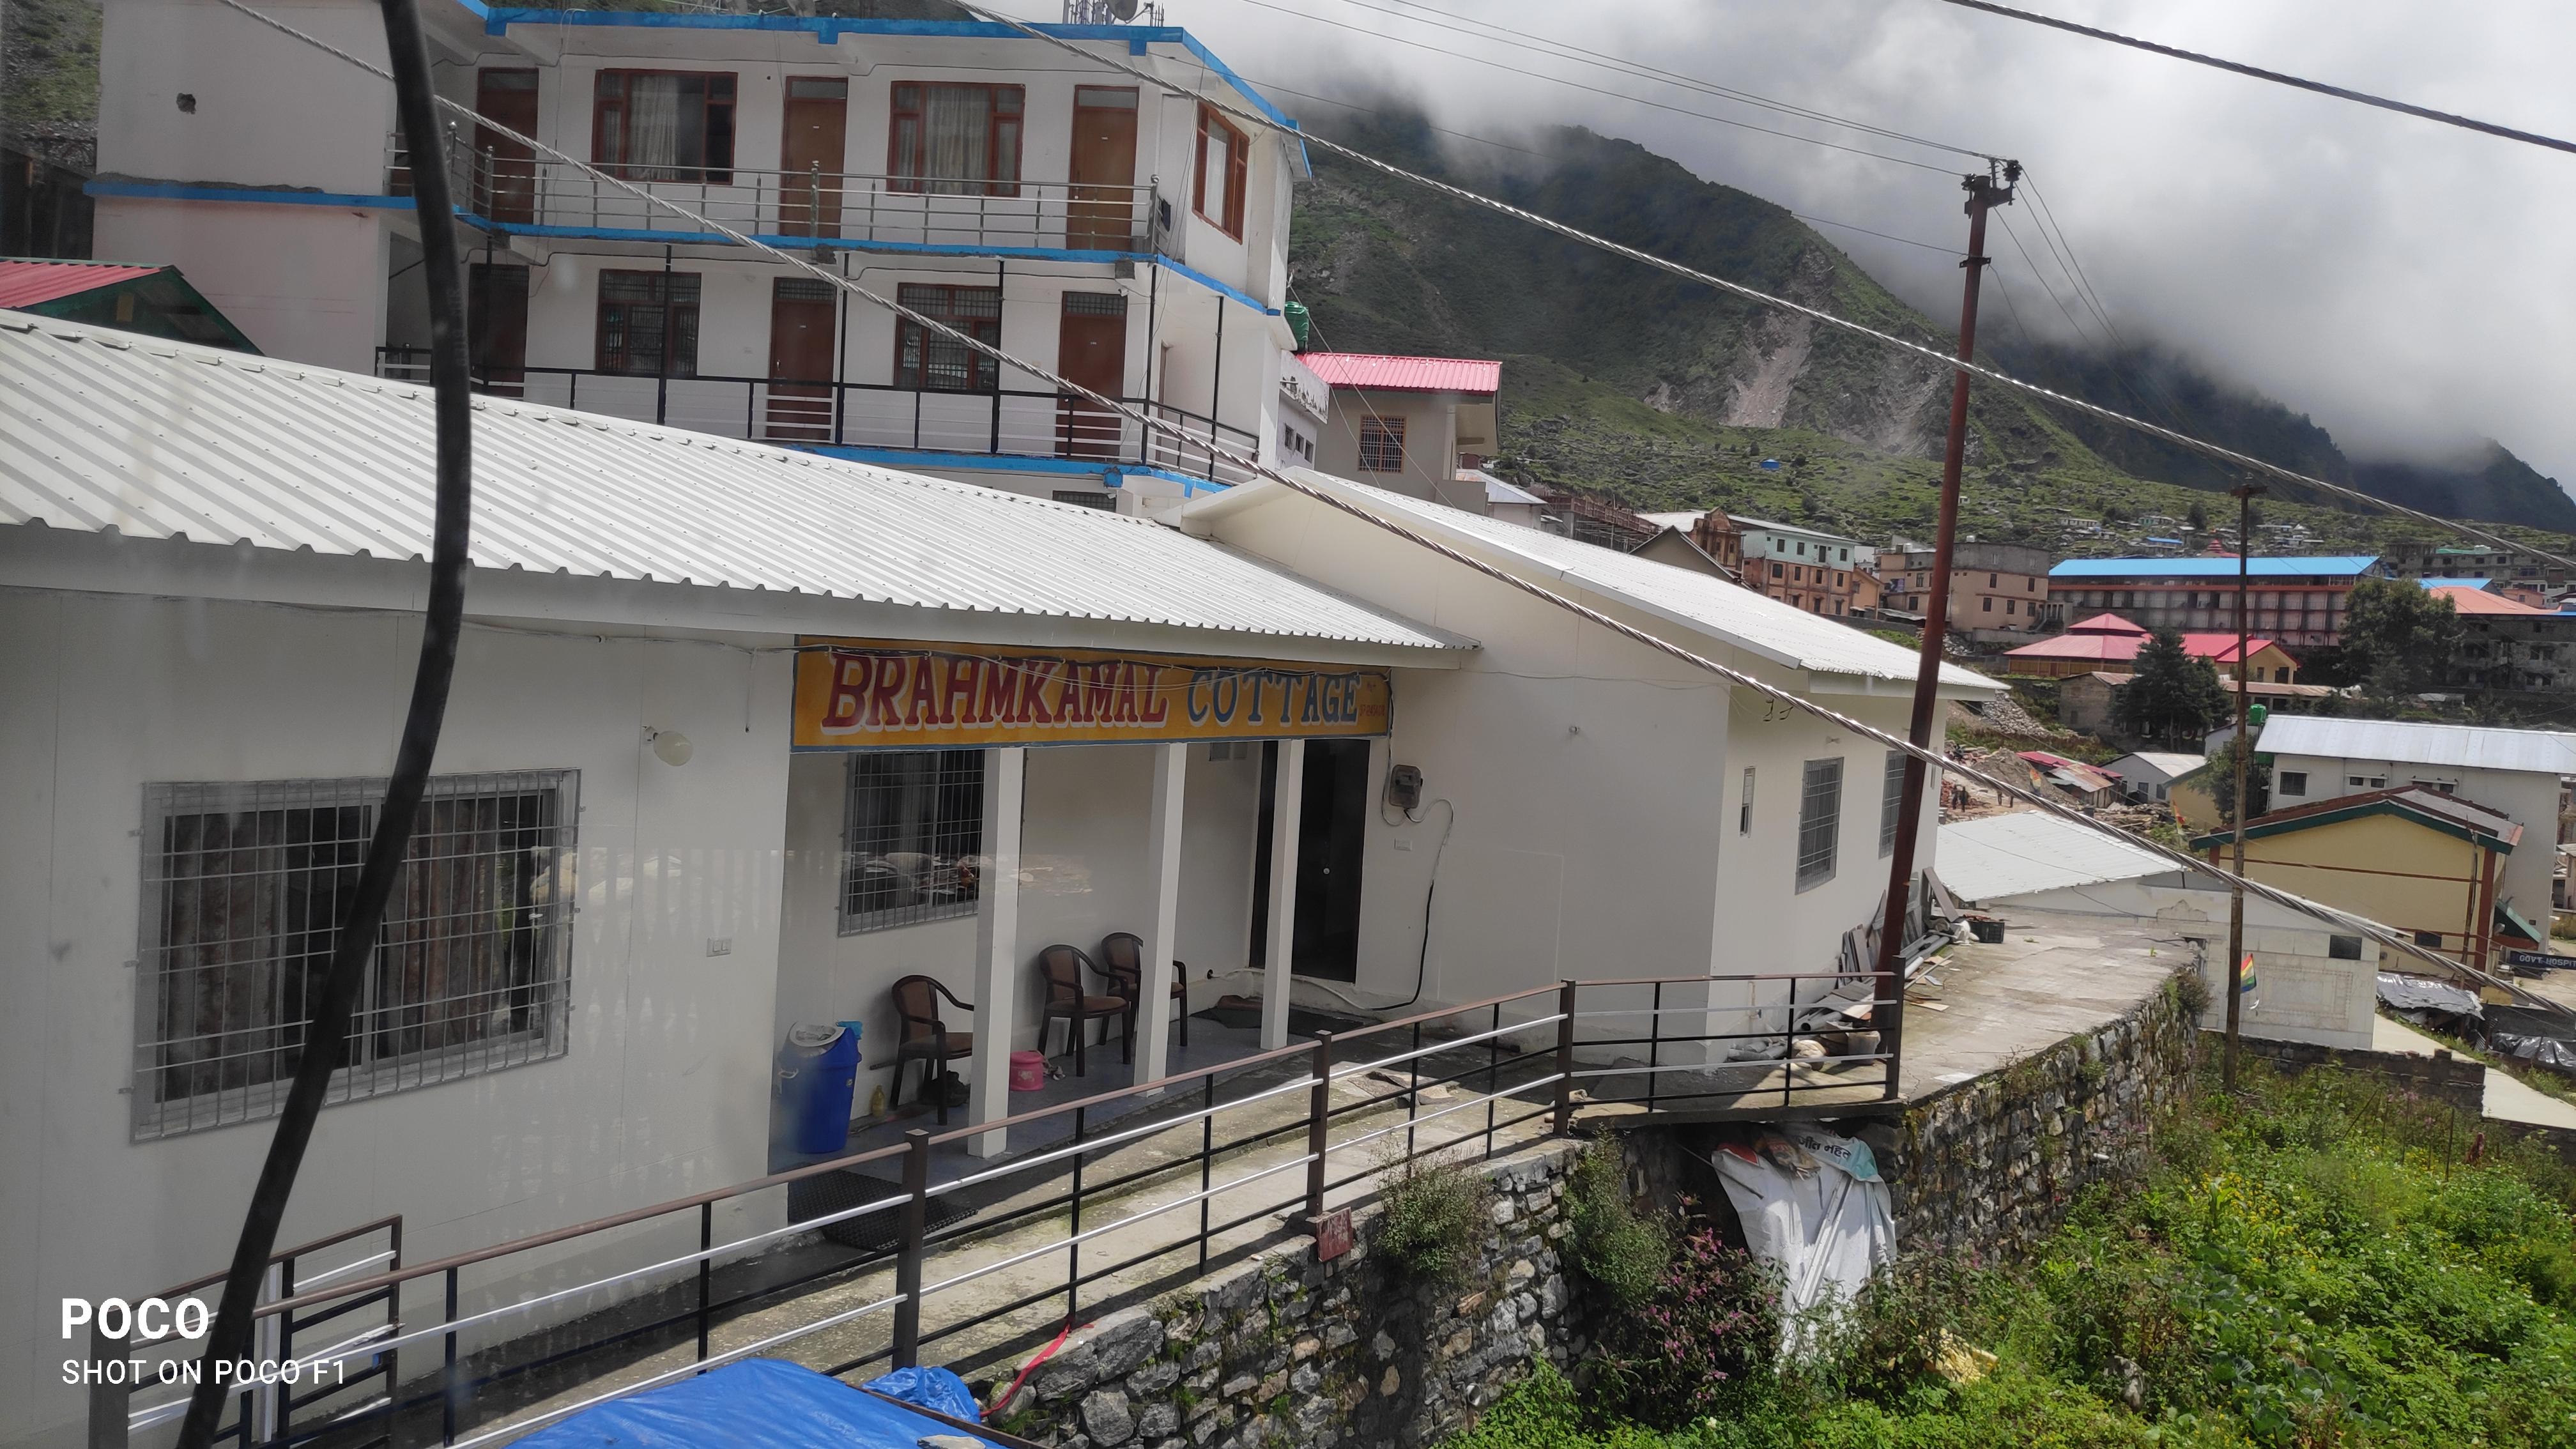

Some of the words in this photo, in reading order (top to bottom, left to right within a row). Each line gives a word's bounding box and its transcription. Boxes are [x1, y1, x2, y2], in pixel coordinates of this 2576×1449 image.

[822, 653, 1169, 734] BRAHMKAMAL
[1188, 670, 1361, 726] COTTAGE
[2519, 954, 2543, 963] GOVT
